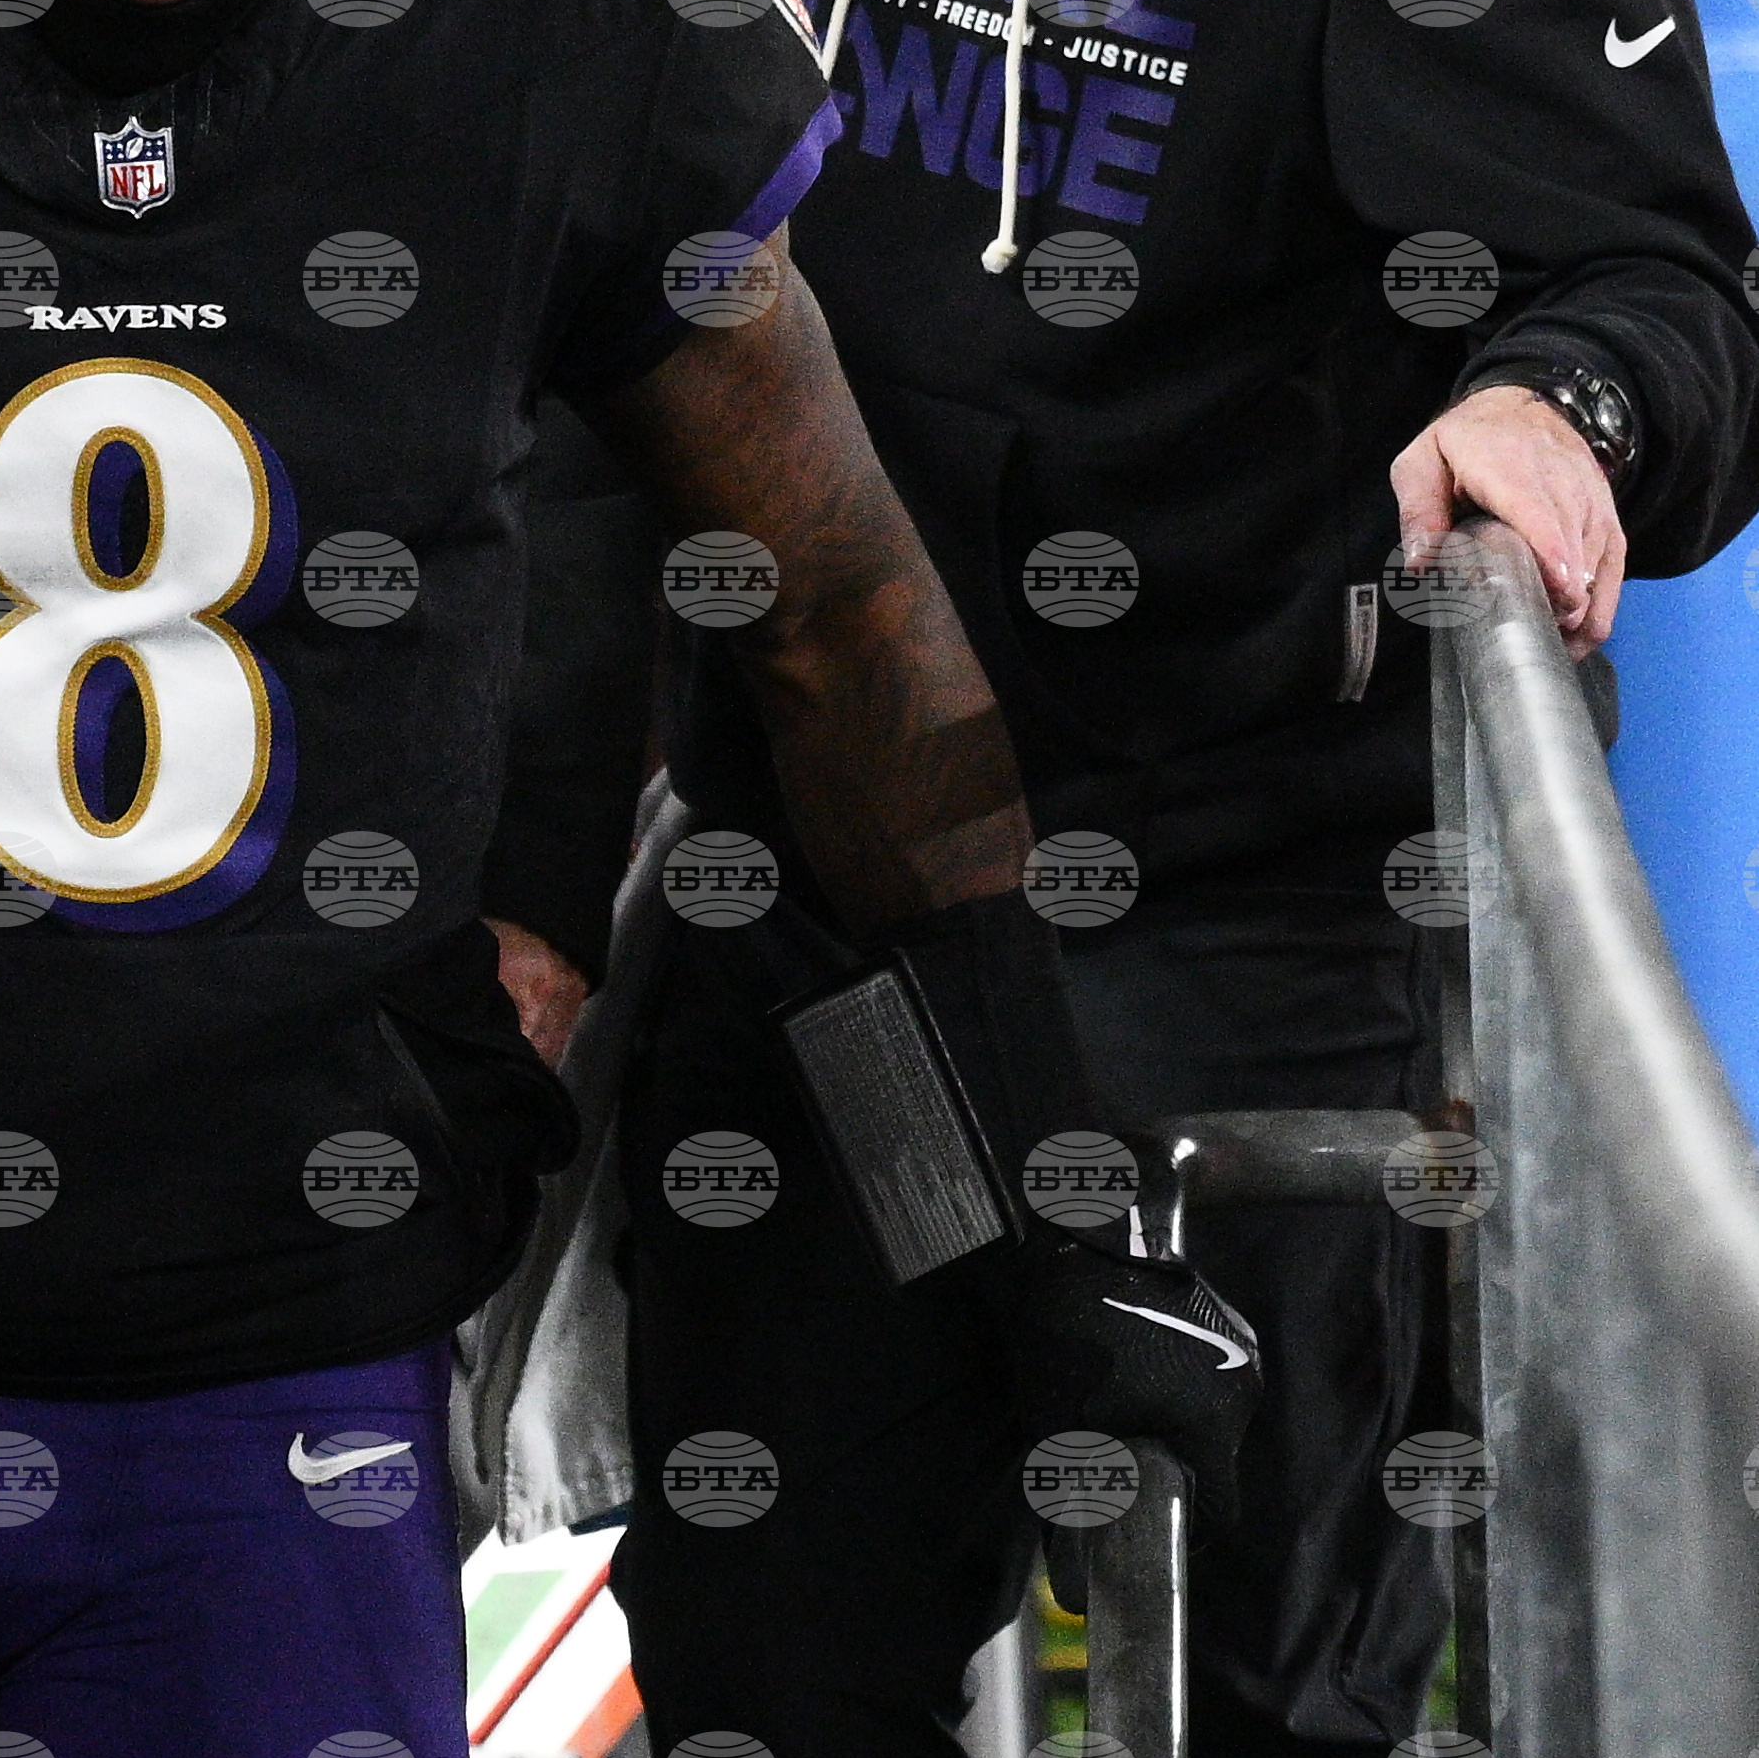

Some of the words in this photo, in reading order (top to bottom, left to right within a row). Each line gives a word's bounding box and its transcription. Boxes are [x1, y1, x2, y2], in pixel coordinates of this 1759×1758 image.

[1062, 37, 1189, 86] JUSTICE
[110, 161, 165, 203] NFL
[24, 303, 228, 332] RAVENS
